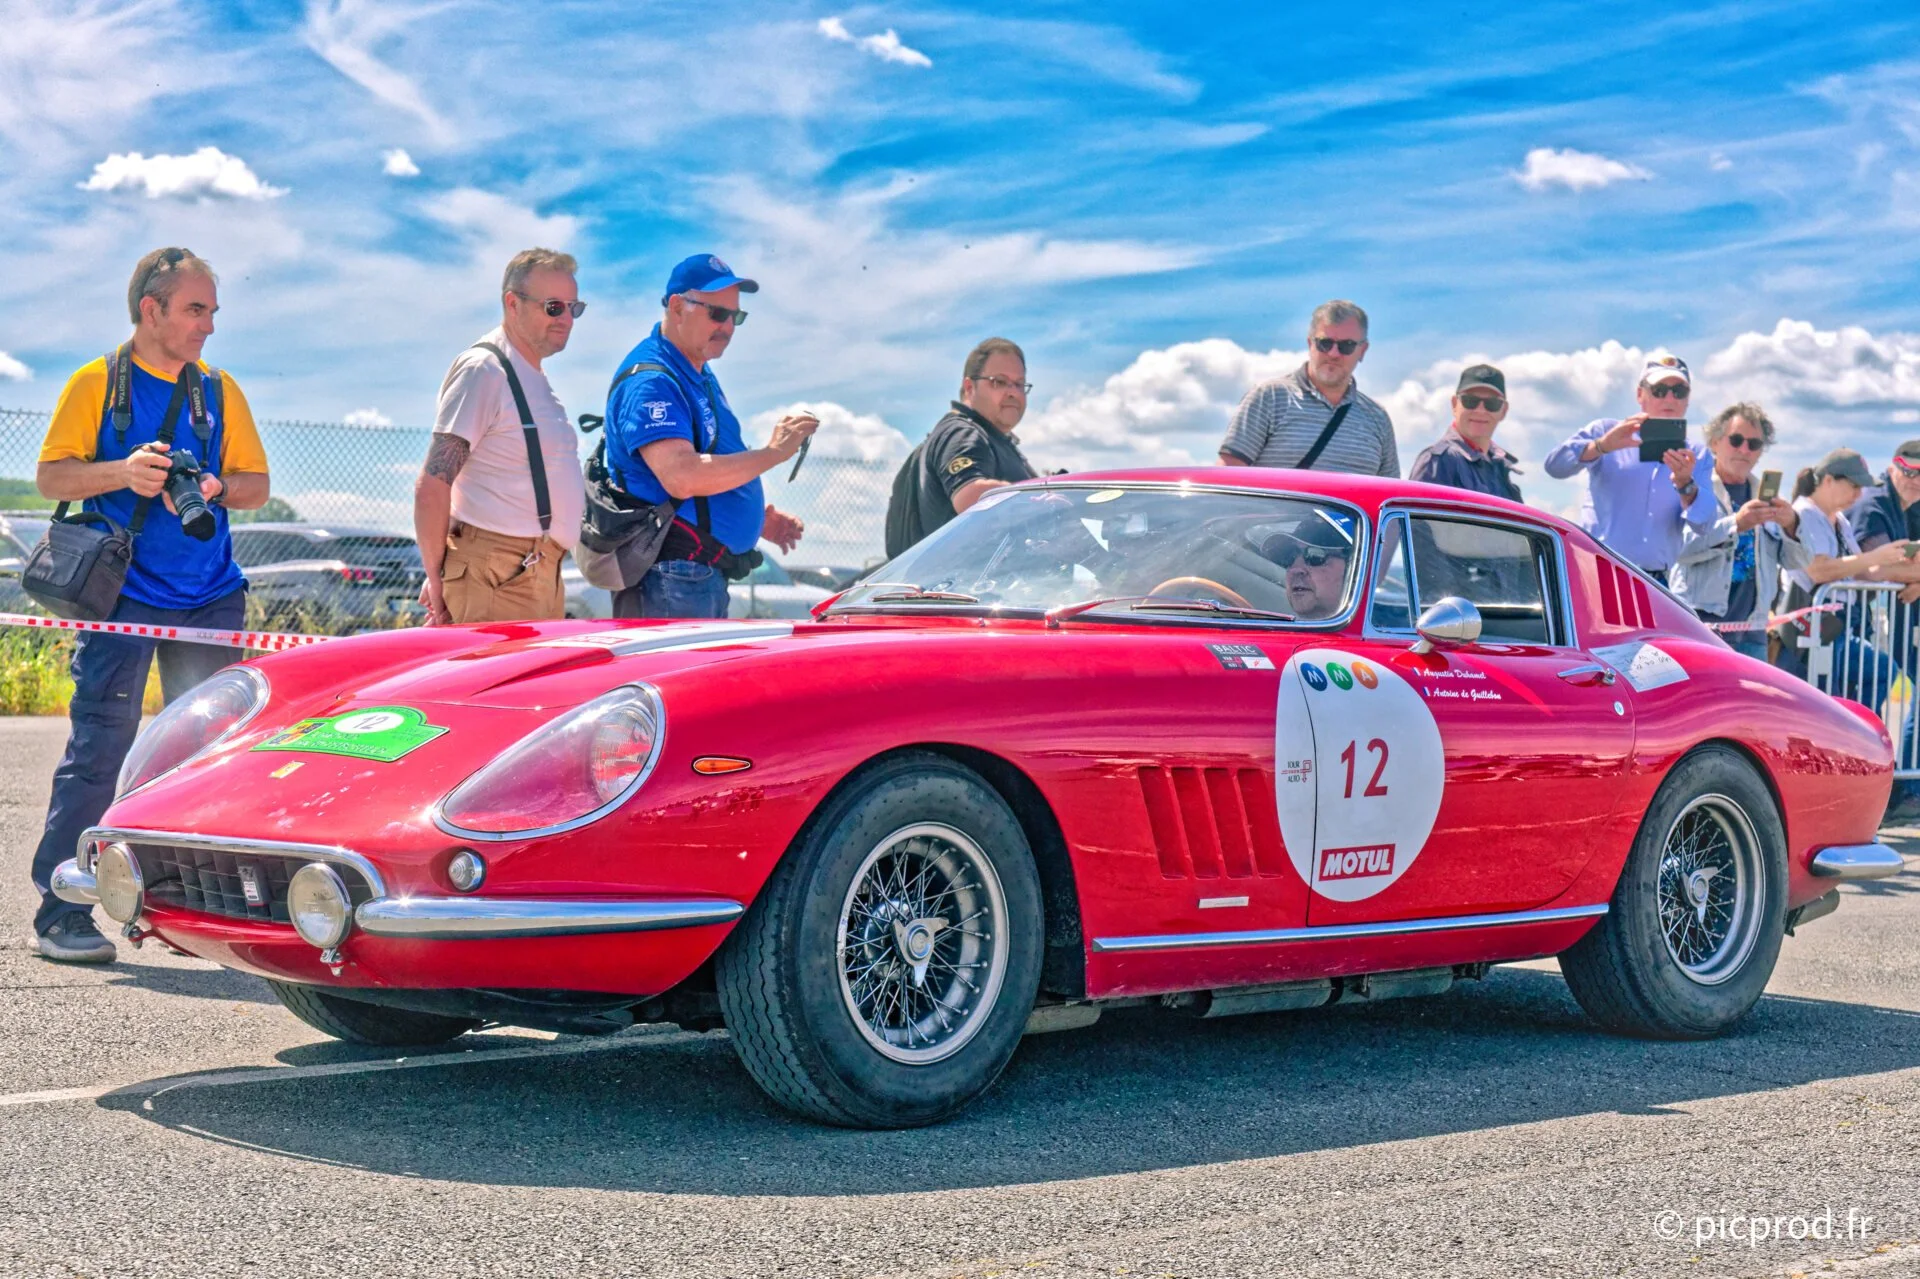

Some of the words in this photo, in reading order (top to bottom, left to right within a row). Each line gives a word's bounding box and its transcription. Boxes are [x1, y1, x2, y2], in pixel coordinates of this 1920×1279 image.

[118, 375, 127, 407] DIGITAL
[192, 386, 203, 417] Canon
[1212, 644, 1256, 653] BALTIC
[1433, 687, 1460, 698] Antoine
[1460, 689, 1470, 698] de
[352, 714, 390, 730] 12
[1340, 738, 1389, 799] 12
[1322, 848, 1392, 877] MOTUL
